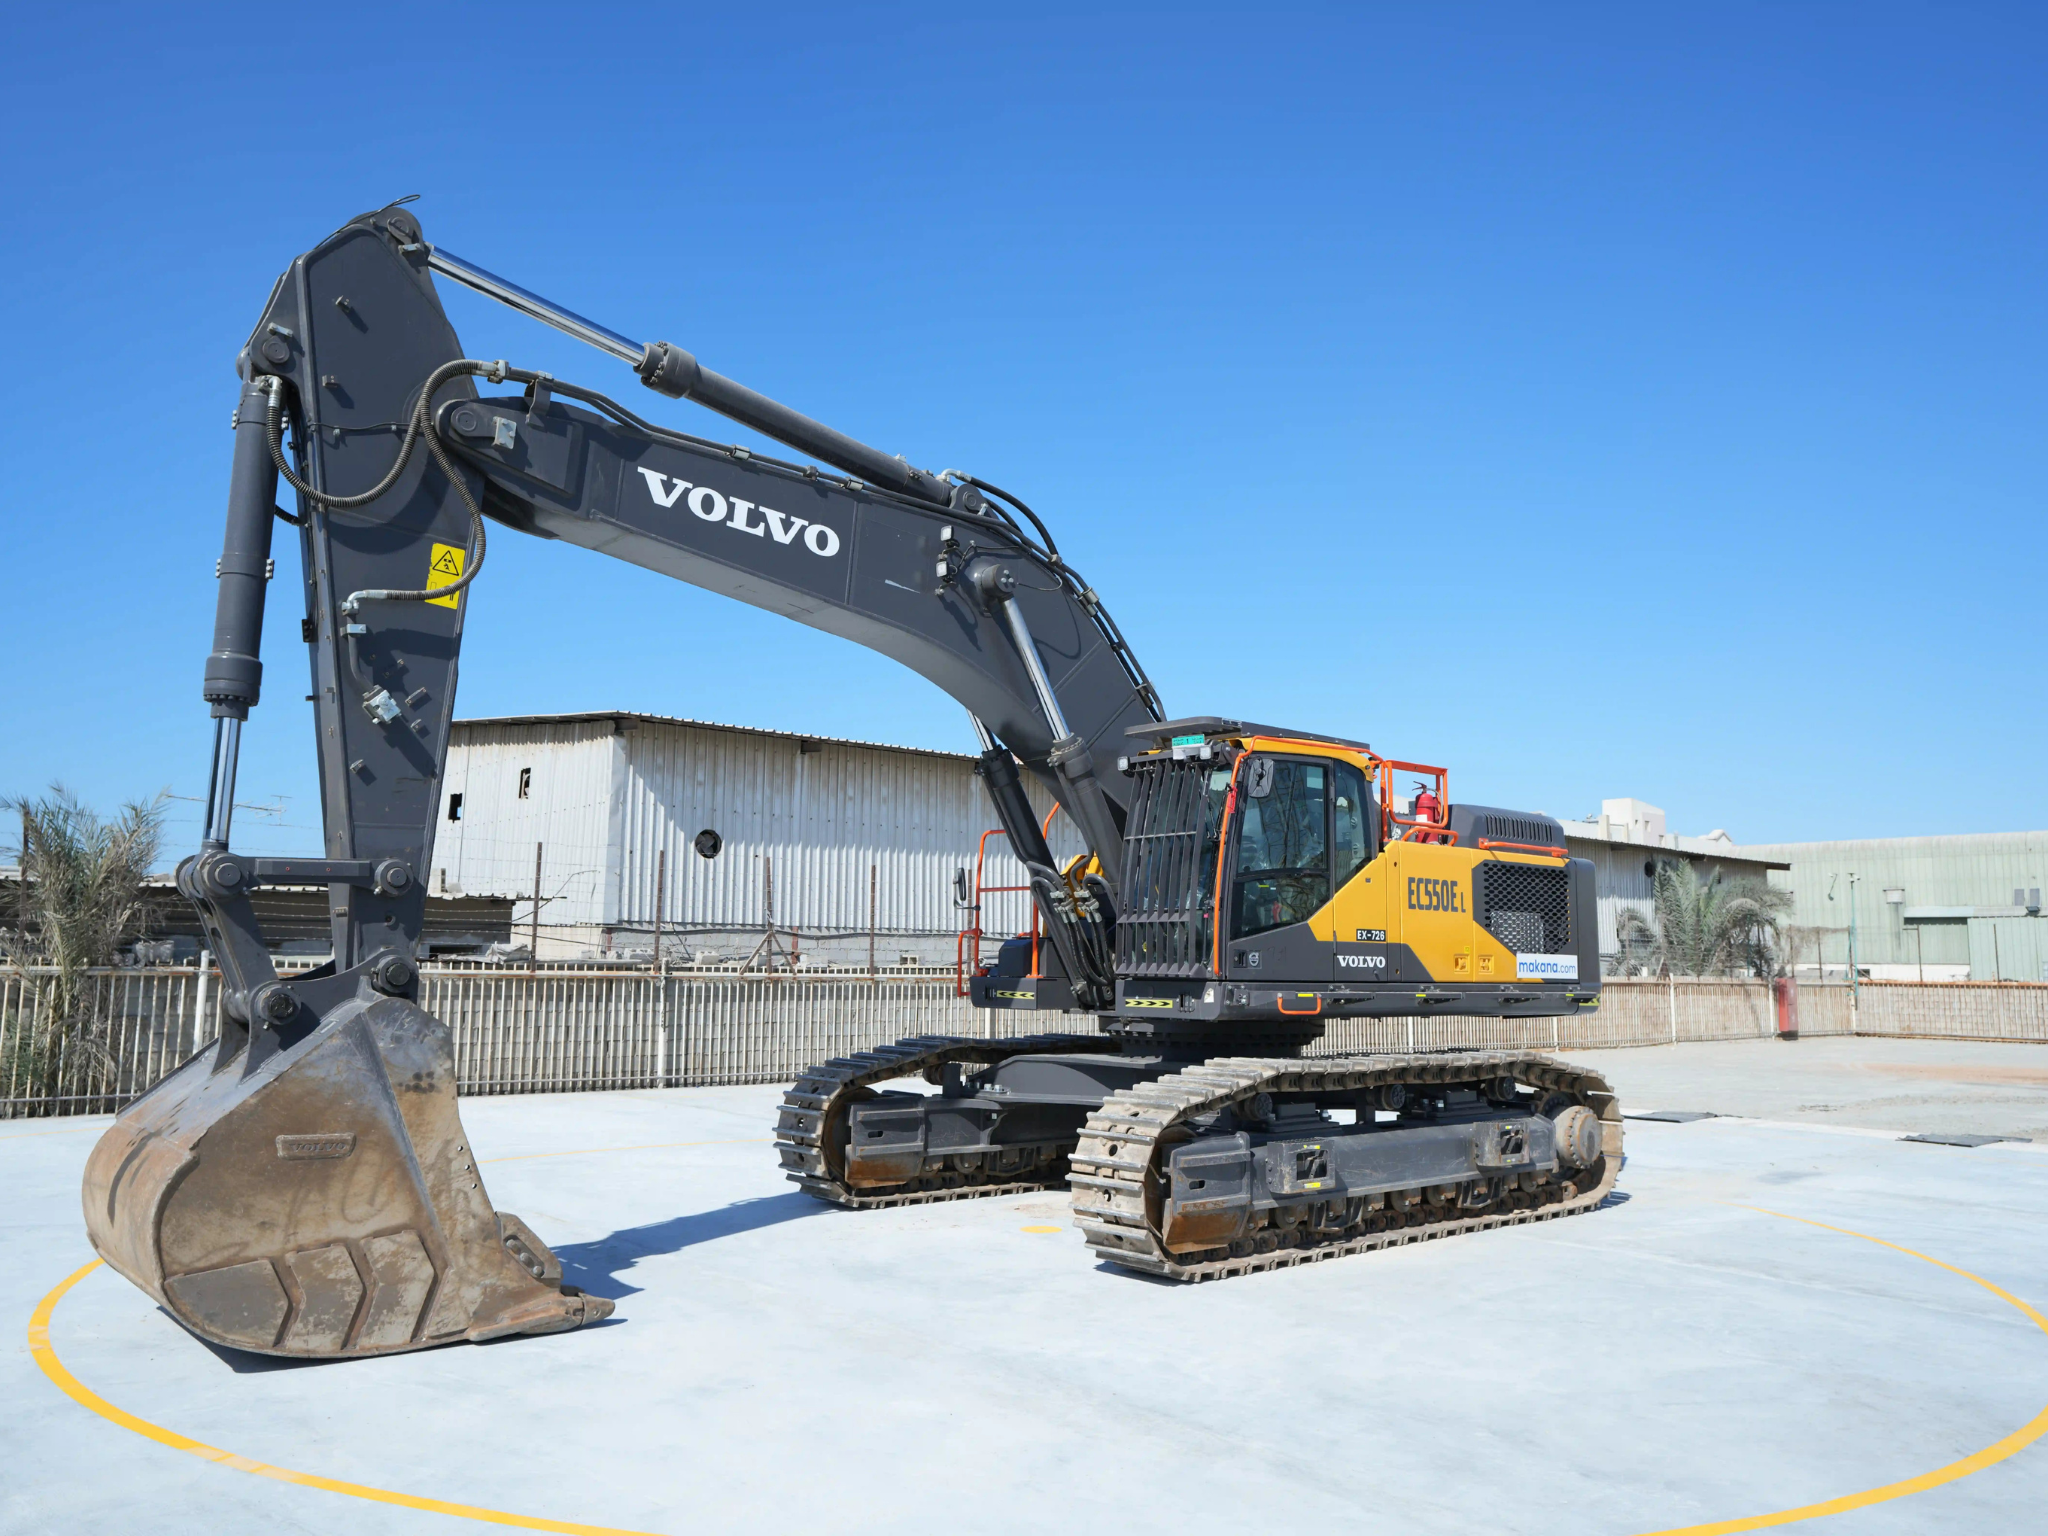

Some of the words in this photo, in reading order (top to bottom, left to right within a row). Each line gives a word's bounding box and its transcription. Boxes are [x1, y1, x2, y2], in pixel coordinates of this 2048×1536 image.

[637, 466, 840, 557] VOLVO
[1357, 930, 1385, 941] EX-726
[1337, 955, 1386, 968] VOLVO
[1518, 959, 1576, 974] makana.com
[288, 1142, 347, 1152] VOLVO
